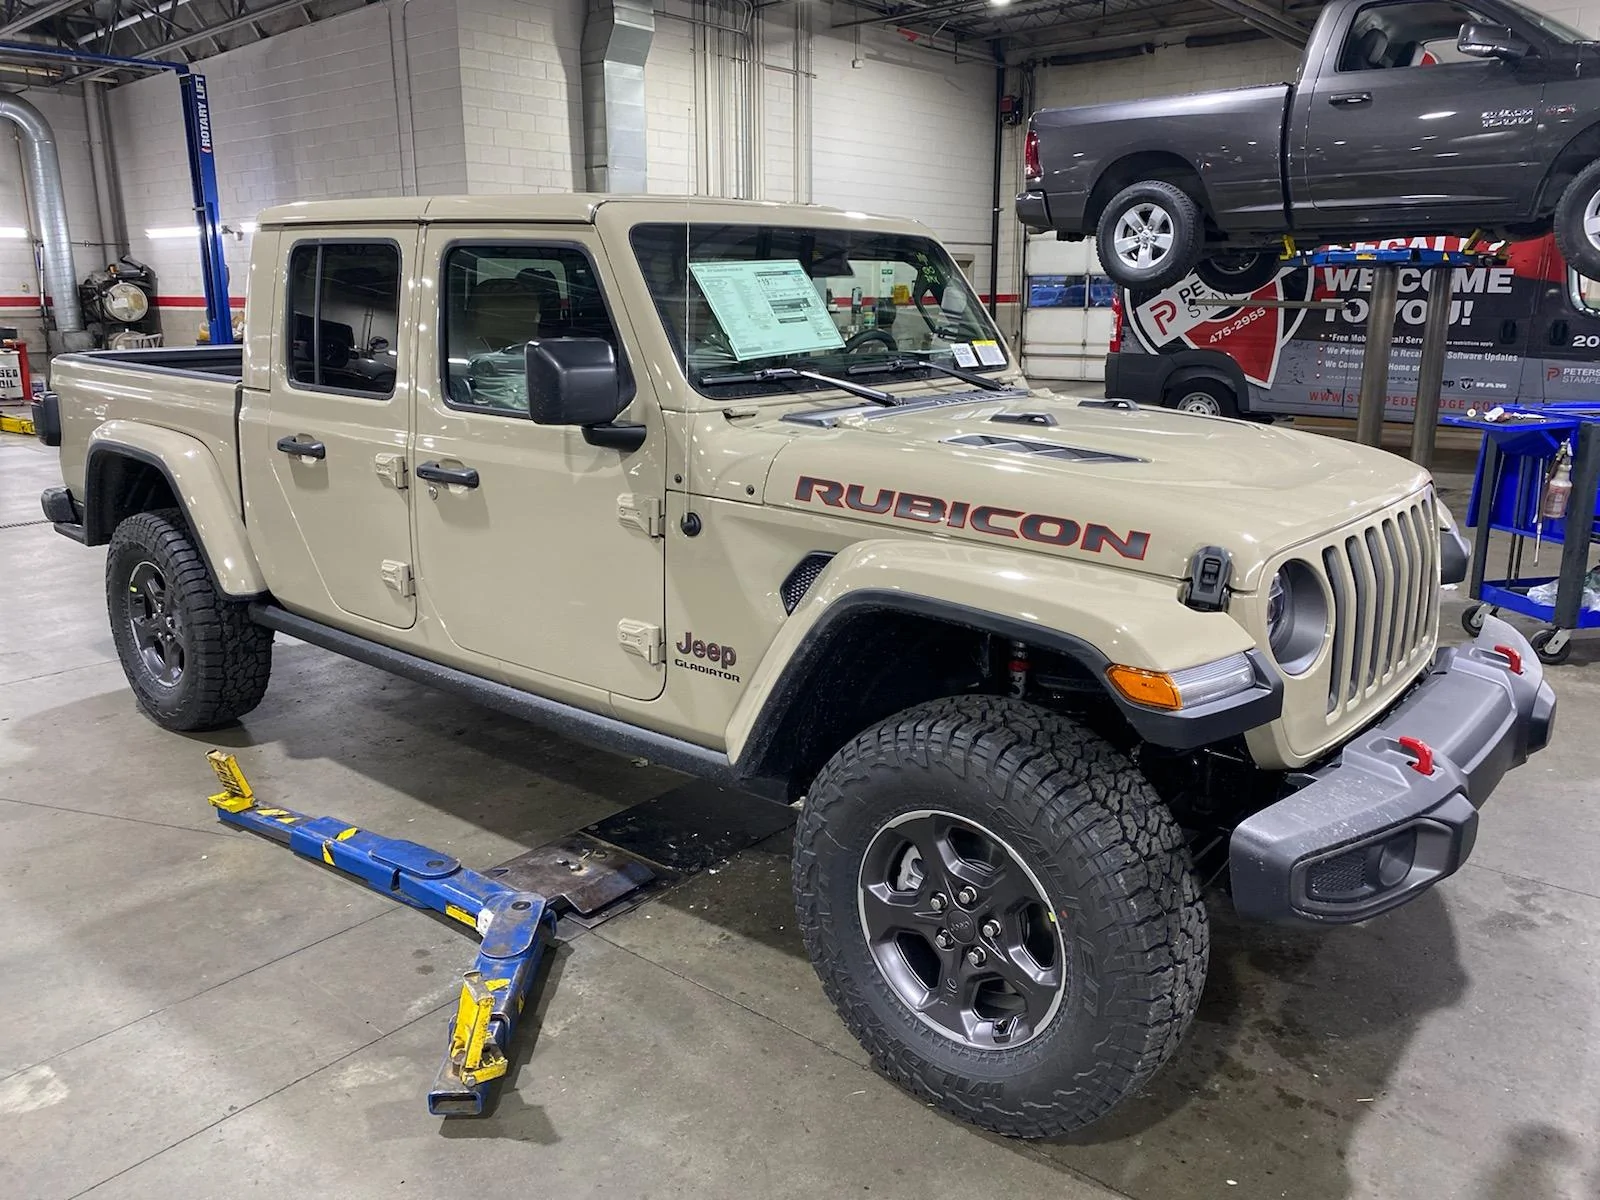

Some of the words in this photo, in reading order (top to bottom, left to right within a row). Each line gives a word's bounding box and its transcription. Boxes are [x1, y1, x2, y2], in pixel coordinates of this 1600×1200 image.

[194, 75, 206, 100] LIFT
[197, 102, 211, 147] ROTARY
[1209, 306, 1267, 344] 475-2955
[1325, 360, 1336, 369] We
[1338, 360, 1359, 370] Come
[1388, 363, 1410, 372] Home
[1447, 351, 1482, 361] Software
[1484, 352, 1518, 363] Updates
[1476, 381, 1507, 389] RAM
[794, 475, 1151, 561] RUBICON
[676, 632, 736, 669] Jeep
[674, 658, 740, 683] GLADIATOR
